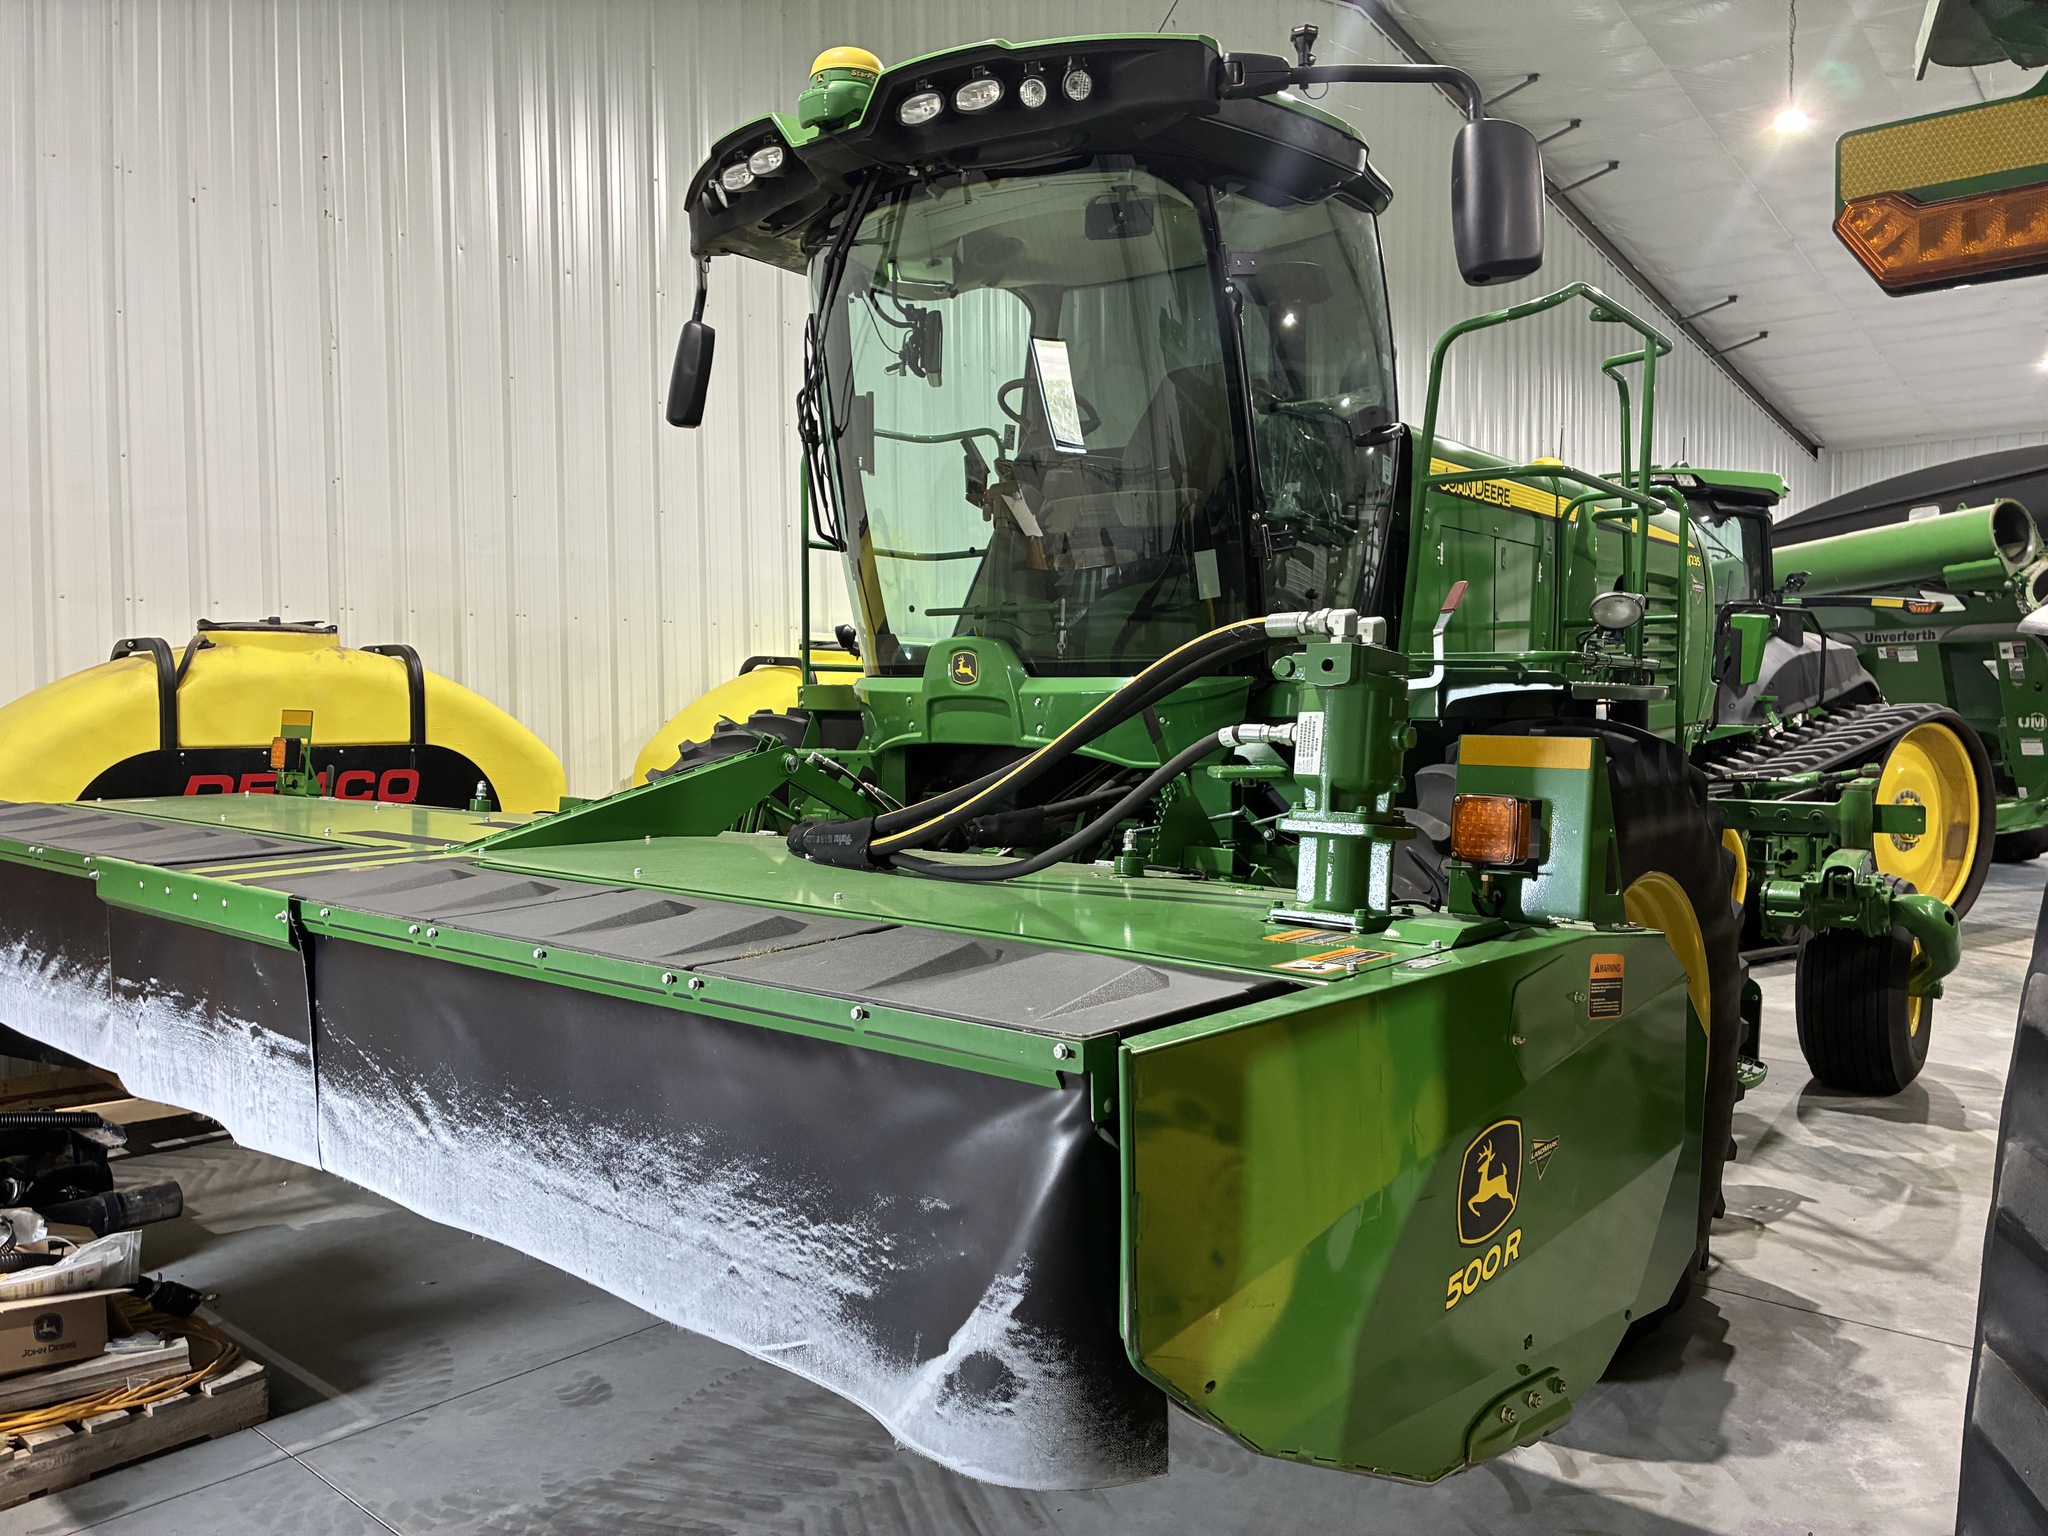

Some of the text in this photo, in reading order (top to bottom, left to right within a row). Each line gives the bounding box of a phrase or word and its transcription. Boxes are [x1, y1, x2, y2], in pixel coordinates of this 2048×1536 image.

[1475, 480, 1512, 507] DEERE
[1865, 629, 1936, 643] Unverferth
[2018, 715, 2046, 729] UM
[183, 768, 420, 802] DECO
[1599, 963, 1621, 973] WARNING
[21, 1341, 77, 1358] JOHN DEERE
